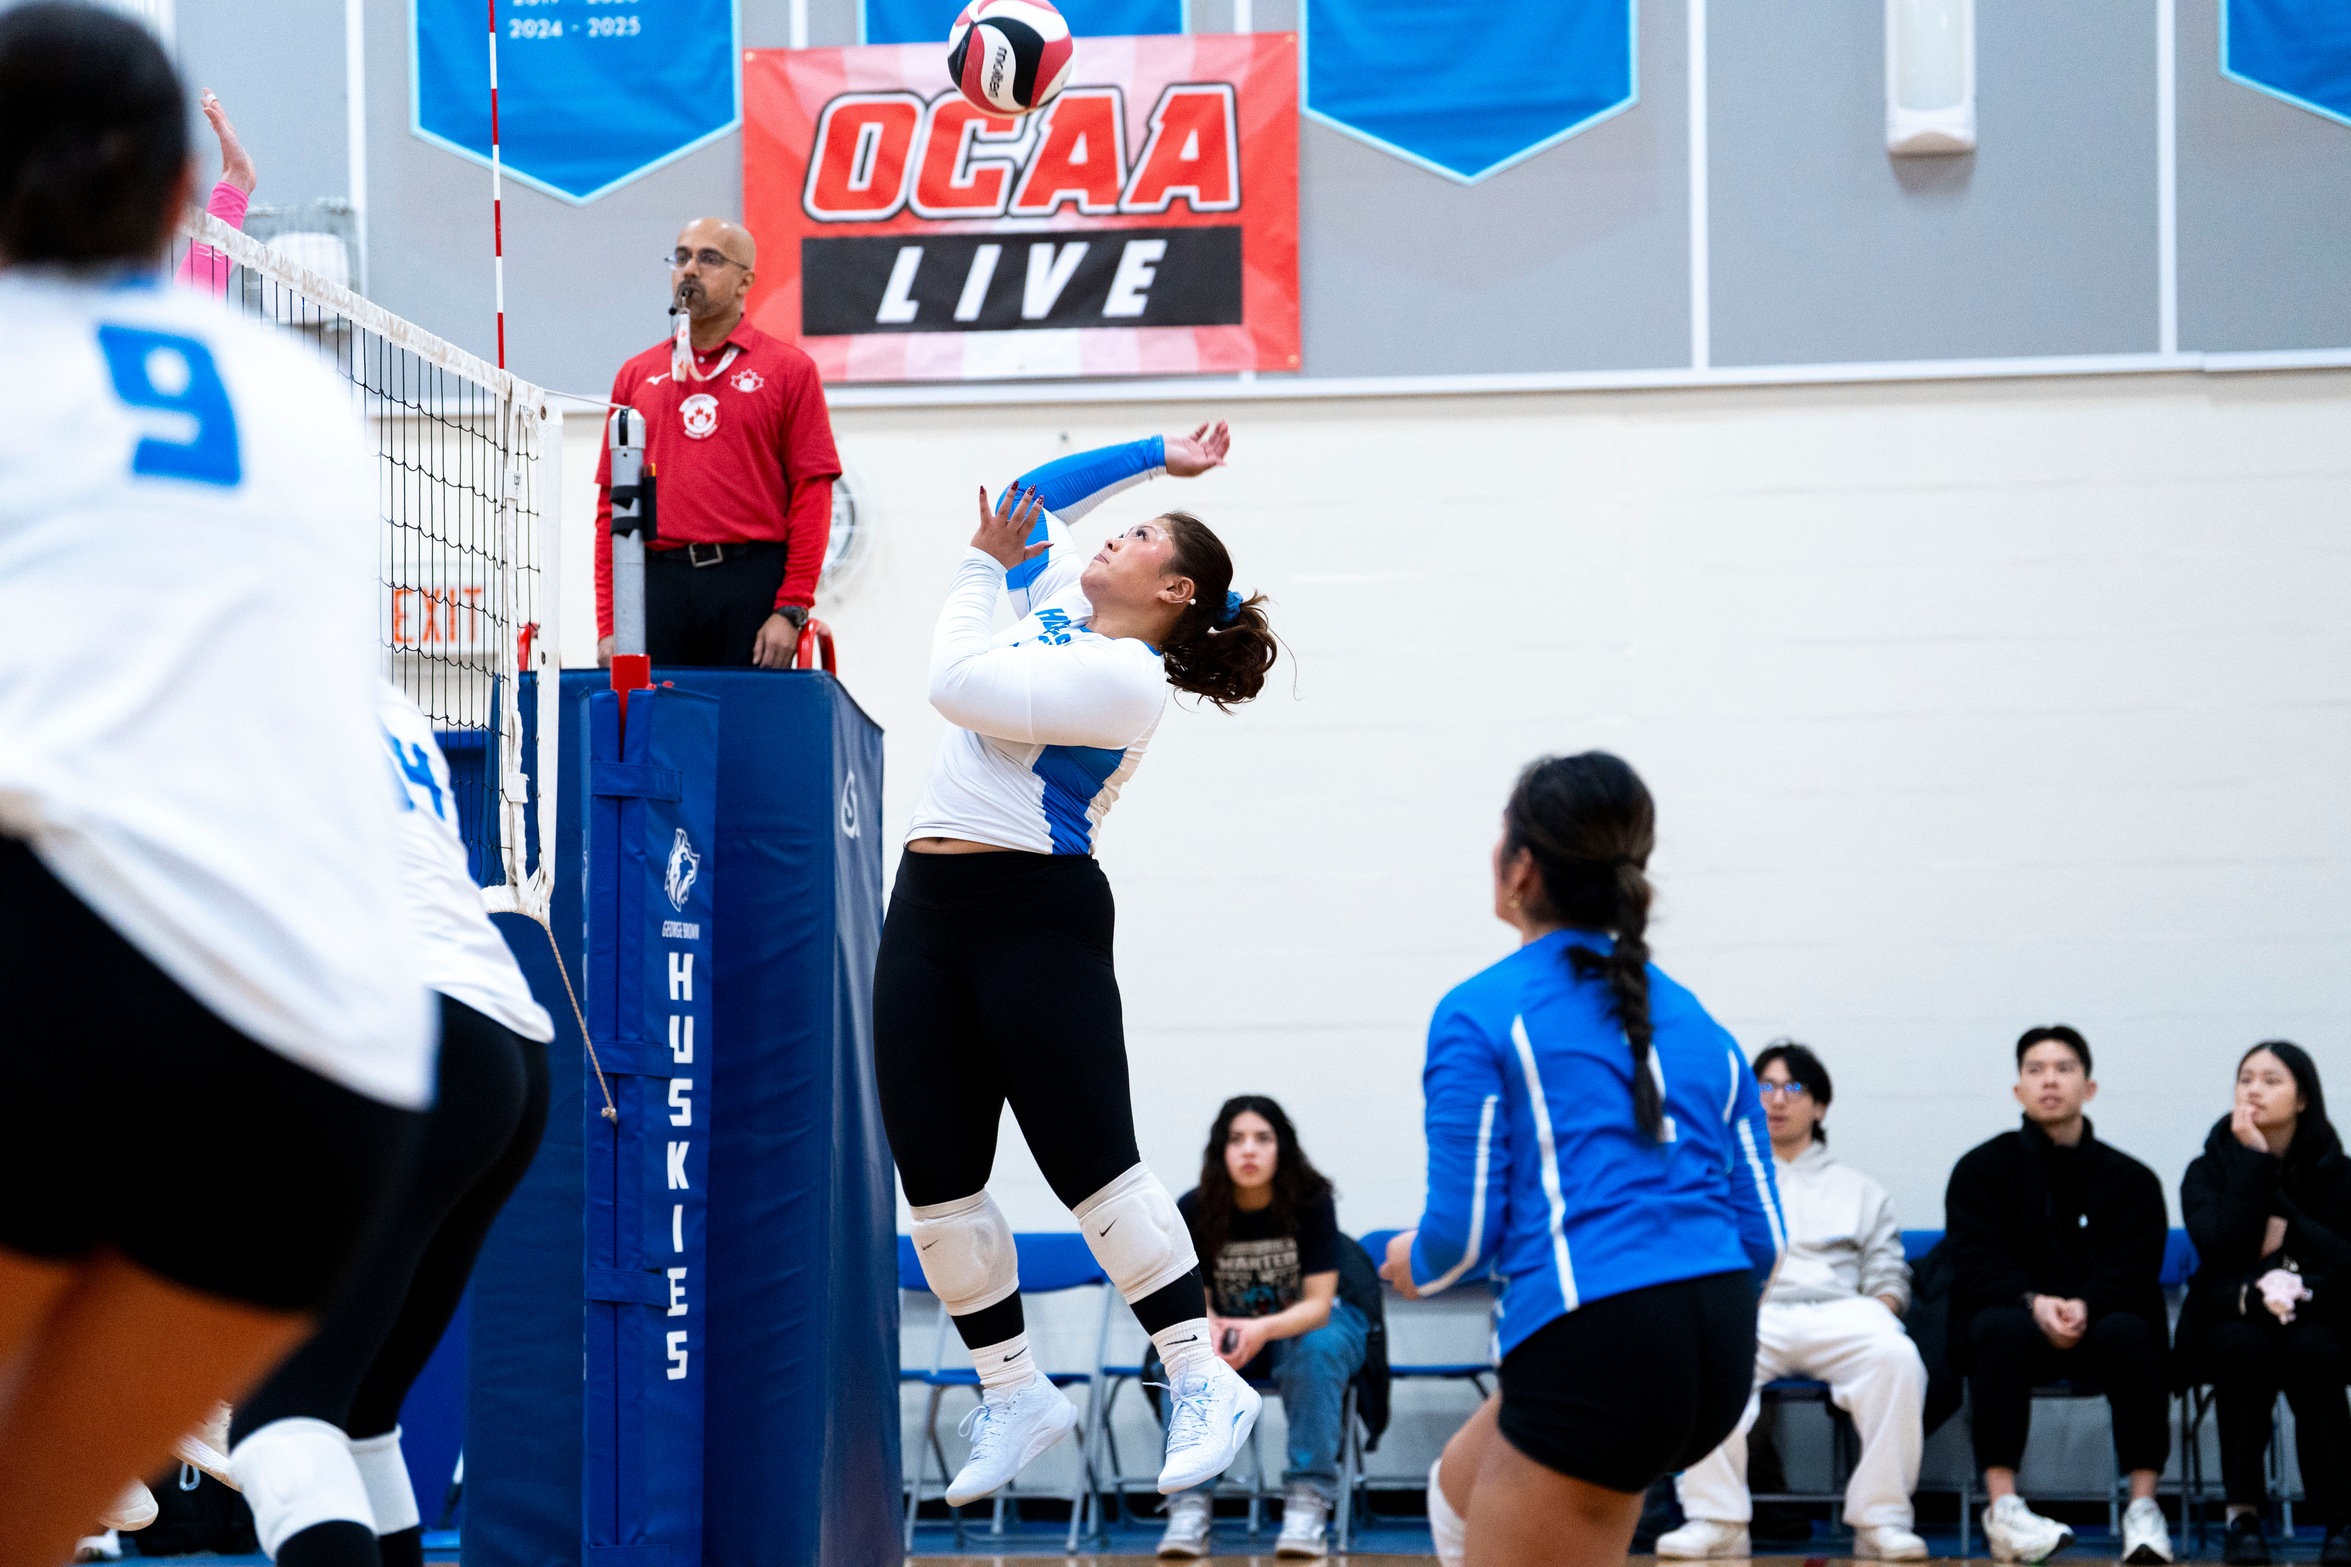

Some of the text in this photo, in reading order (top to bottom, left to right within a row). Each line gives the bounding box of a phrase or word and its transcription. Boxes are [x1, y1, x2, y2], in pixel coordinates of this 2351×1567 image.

[509, 18, 563, 39] 2024
[587, 15, 642, 37] 2025
[988, 46, 1007, 98] molten
[802, 82, 1241, 222] OCAA
[875, 240, 1167, 323] LIVE
[97, 323, 242, 487] 9
[393, 587, 483, 643] EXIT
[667, 952, 694, 1380] HUSKIES
